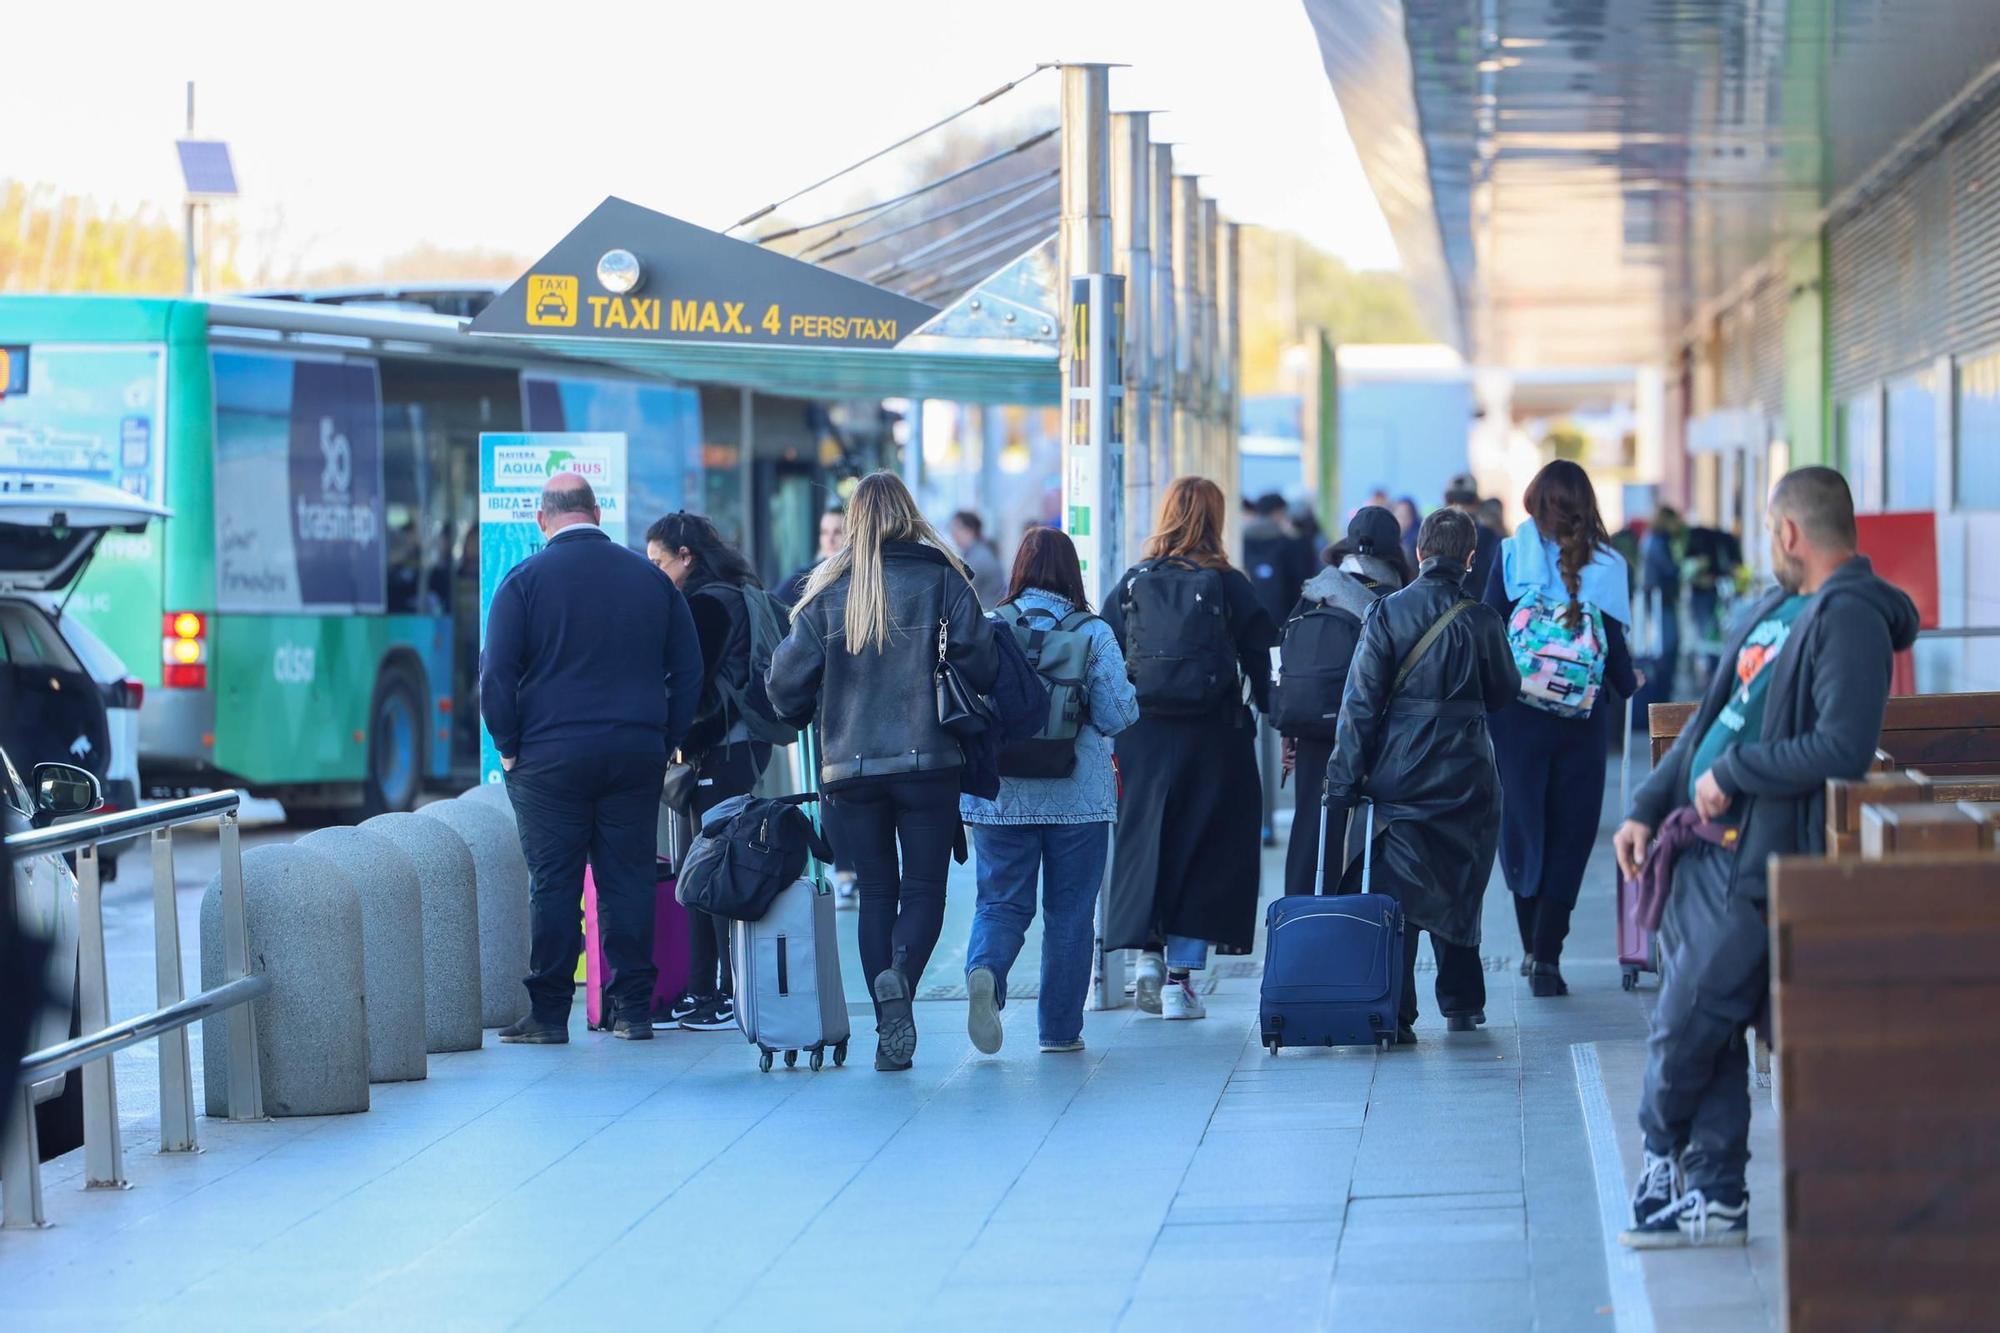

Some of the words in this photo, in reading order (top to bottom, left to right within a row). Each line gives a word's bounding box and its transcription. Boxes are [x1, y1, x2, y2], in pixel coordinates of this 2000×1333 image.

[537, 279, 569, 290] TAXI
[587, 296, 661, 331] TAXI
[670, 298, 752, 334] MAX.
[761, 304, 781, 336] 4
[790, 315, 897, 341] PERS/TAXI
[503, 463, 543, 474] AQUA
[573, 463, 601, 473] BUS
[488, 497, 520, 509] IBIZA
